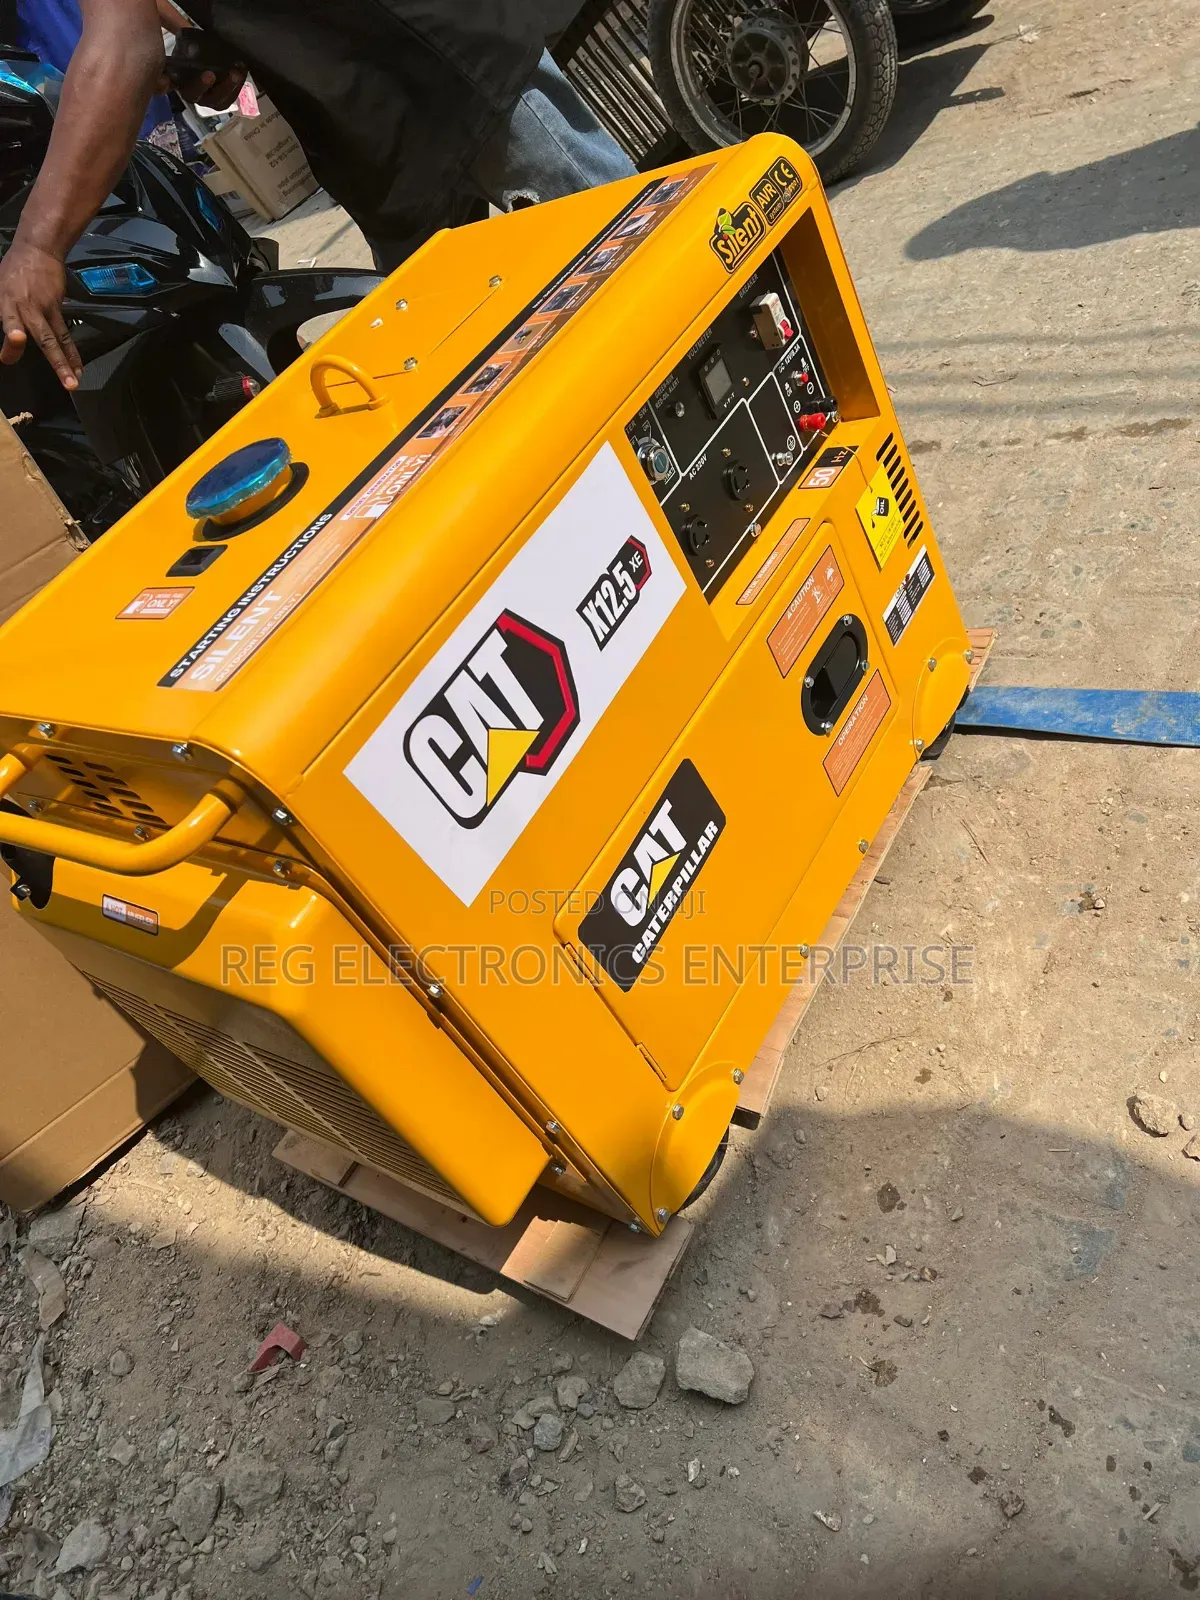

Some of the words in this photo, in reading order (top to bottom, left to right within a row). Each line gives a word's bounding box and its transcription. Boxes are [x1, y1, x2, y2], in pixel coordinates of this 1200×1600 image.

[243, 126, 260, 141] China
[774, 162, 793, 187] CE
[756, 183, 776, 209] AVR
[717, 207, 760, 264] Silent
[738, 273, 758, 299] BREAKER
[687, 328, 713, 360] VOLTMETER
[668, 376, 680, 393] ALERT
[778, 362, 786, 374] DC
[786, 388, 793, 397] ON
[625, 420, 637, 435] TER
[638, 406, 650, 419] SW.
[367, 460, 402, 495] GENERATOR
[386, 454, 432, 495] ONLY!
[688, 468, 697, 481] AC
[695, 453, 708, 472] 220V
[808, 468, 836, 486] 50
[831, 449, 849, 463] Hz
[740, 587, 753, 601] LOW
[749, 578, 759, 587] OIL
[756, 550, 779, 578] WARNING!
[169, 605, 241, 679] STARTING
[238, 512, 333, 606] INSTRUCTIONS
[582, 560, 637, 643] X12.5
[628, 551, 643, 573] XE
[790, 576, 815, 613] CAUTION
[190, 590, 282, 682] SILENT
[214, 638, 258, 681] OUTDOOR
[255, 619, 276, 638] USE
[407, 626, 545, 820] CAT
[837, 693, 868, 746] OPERATION
[610, 798, 687, 927] CAT
[631, 820, 719, 964] CATERPILLAR
